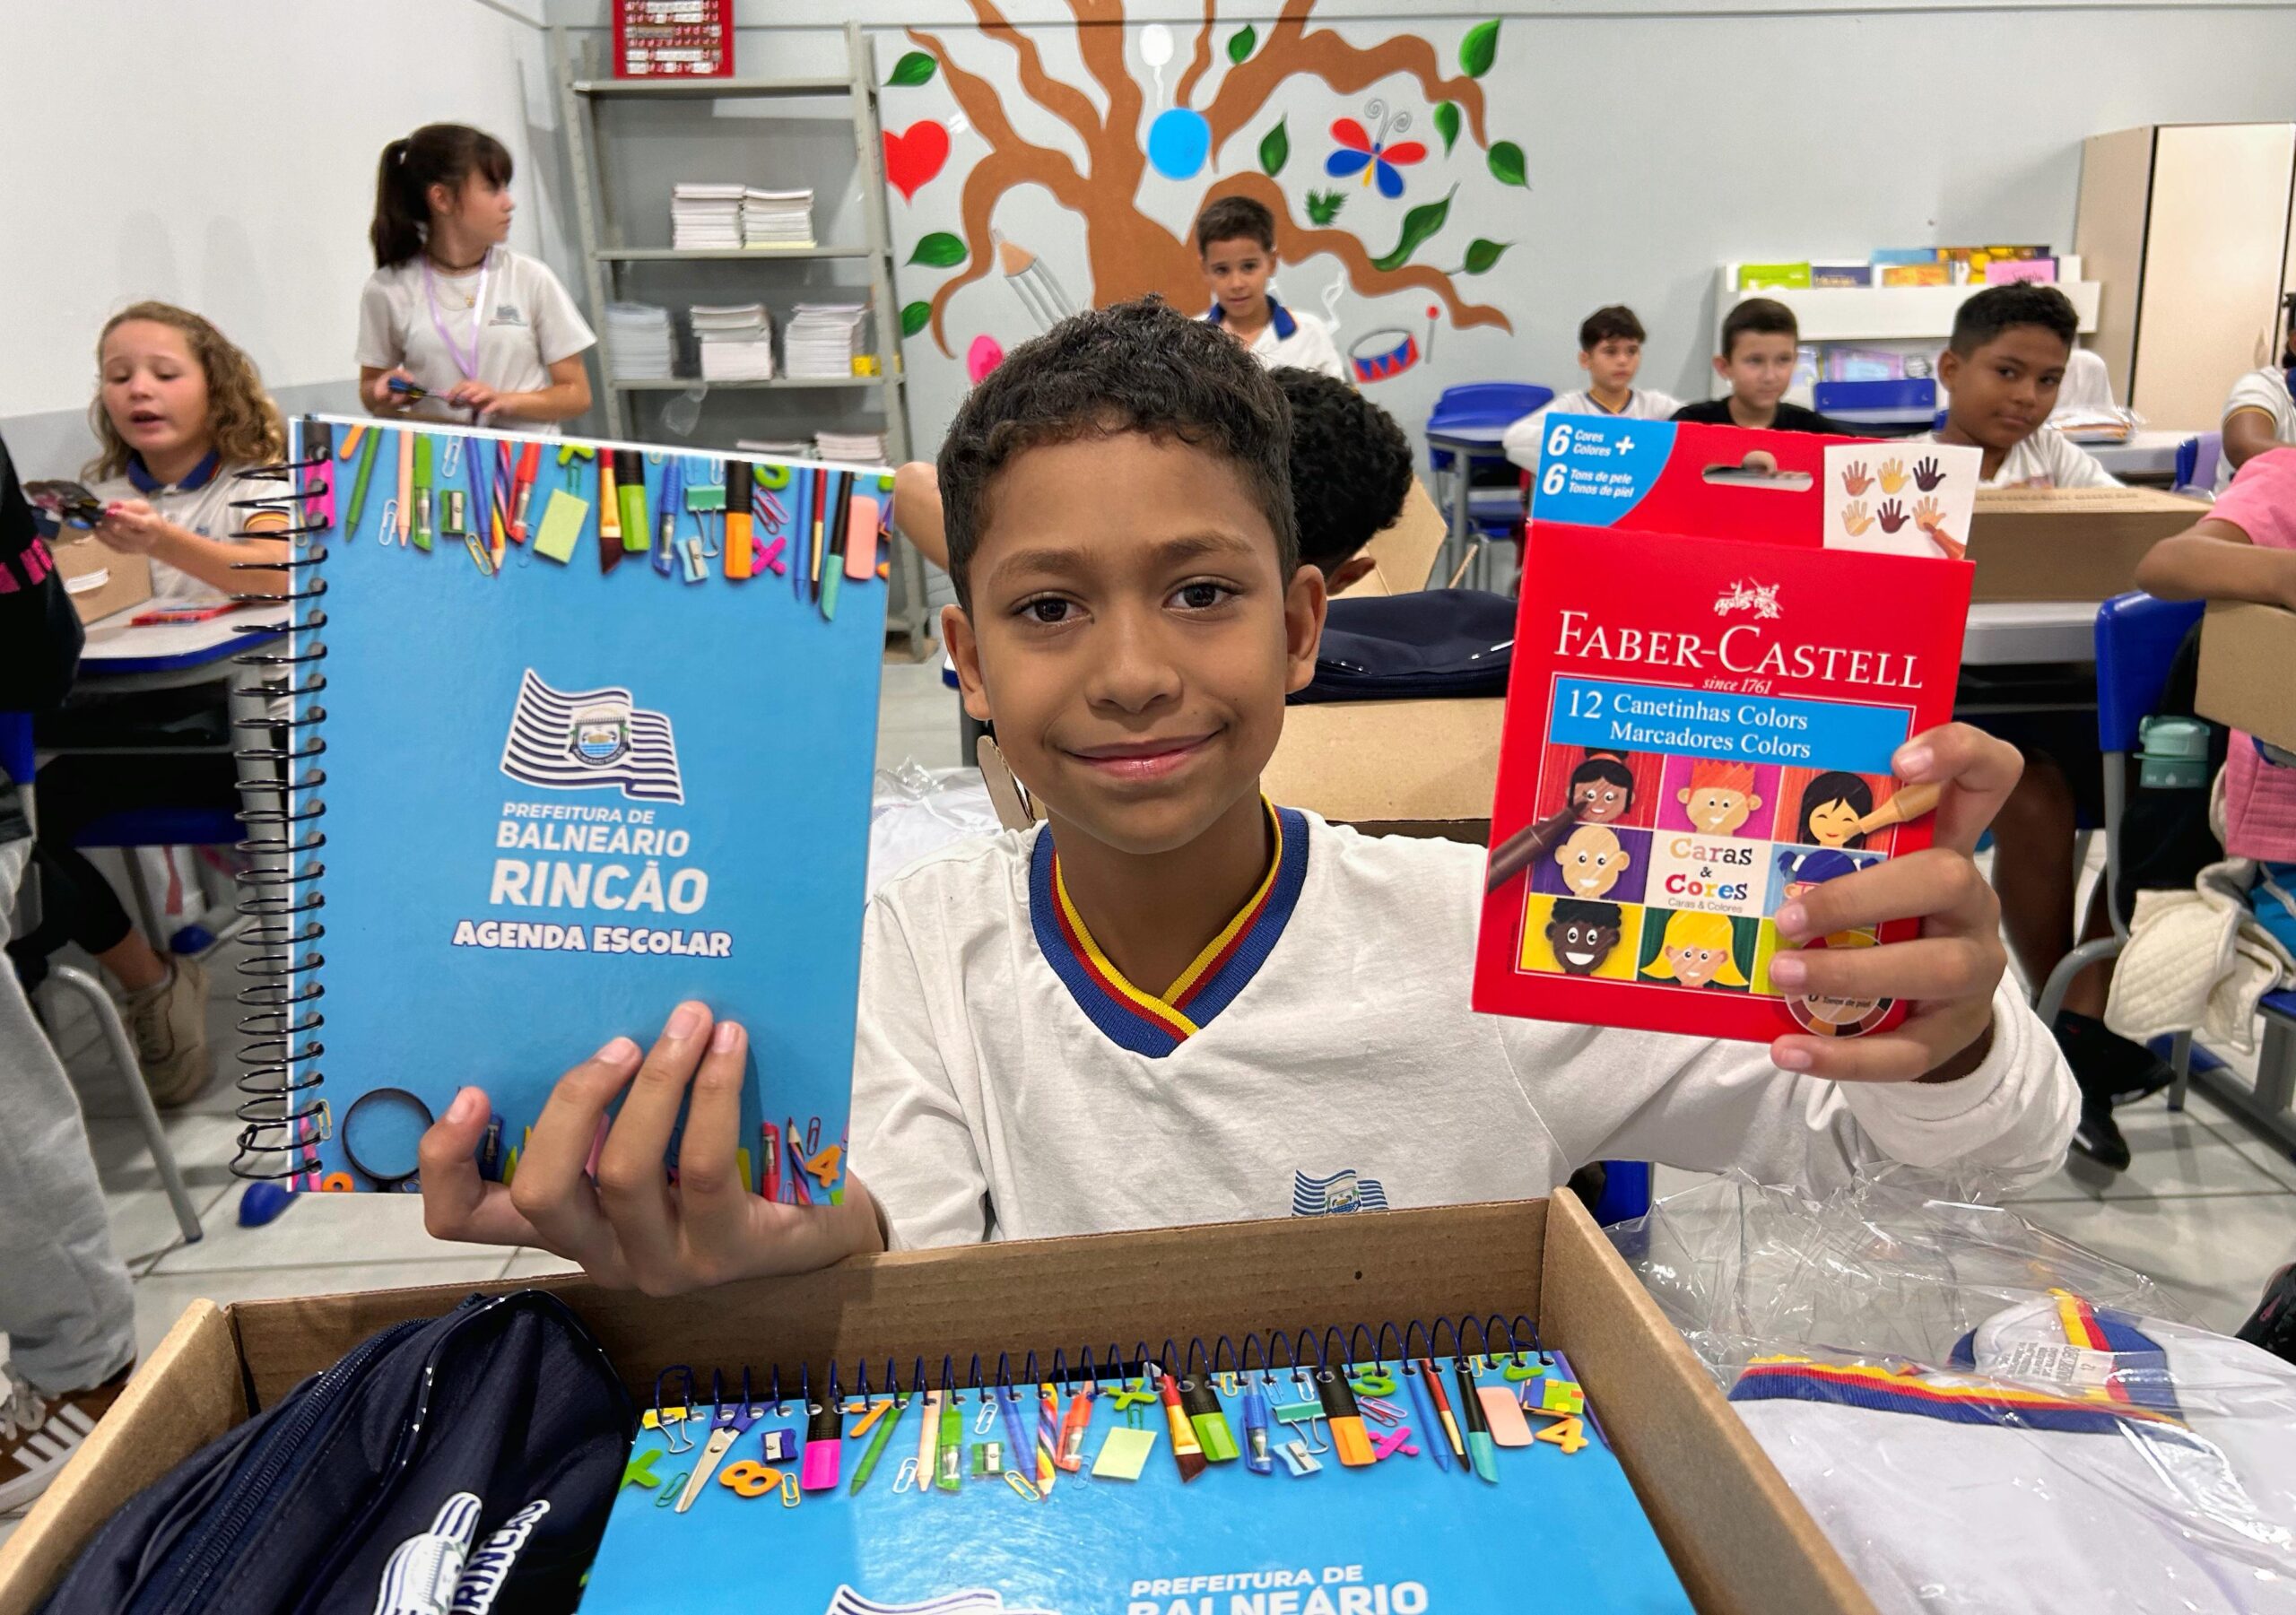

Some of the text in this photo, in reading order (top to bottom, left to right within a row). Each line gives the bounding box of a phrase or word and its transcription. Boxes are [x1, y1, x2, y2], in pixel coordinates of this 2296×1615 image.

[1547, 423, 1573, 457] 6
[1575, 430, 1605, 443] Cores
[1573, 443, 1612, 457] Colores
[1543, 462, 1632, 496] 6 Tons de pele
[1569, 482, 1635, 499] Tonos de piel
[1553, 609, 1924, 690] FABER-CASTELL
[1702, 677, 1772, 696] since 1761
[1568, 689, 1809, 732] 12 Canetinhas Colors
[1610, 721, 1812, 760] Marcadores Colors
[502, 803, 657, 825] PREFEITURA DE
[496, 821, 691, 857] BALNEÁRIO
[1669, 838, 1753, 866] Caras
[490, 858, 710, 916] RINCÃO
[1665, 873, 1749, 901] Cores
[1668, 897, 1695, 908] Caras
[1707, 901, 1744, 914] Colores
[451, 918, 734, 959] AGENDA ESCOLAR
[1130, 1565, 1363, 1598] PREFEITURA DE
